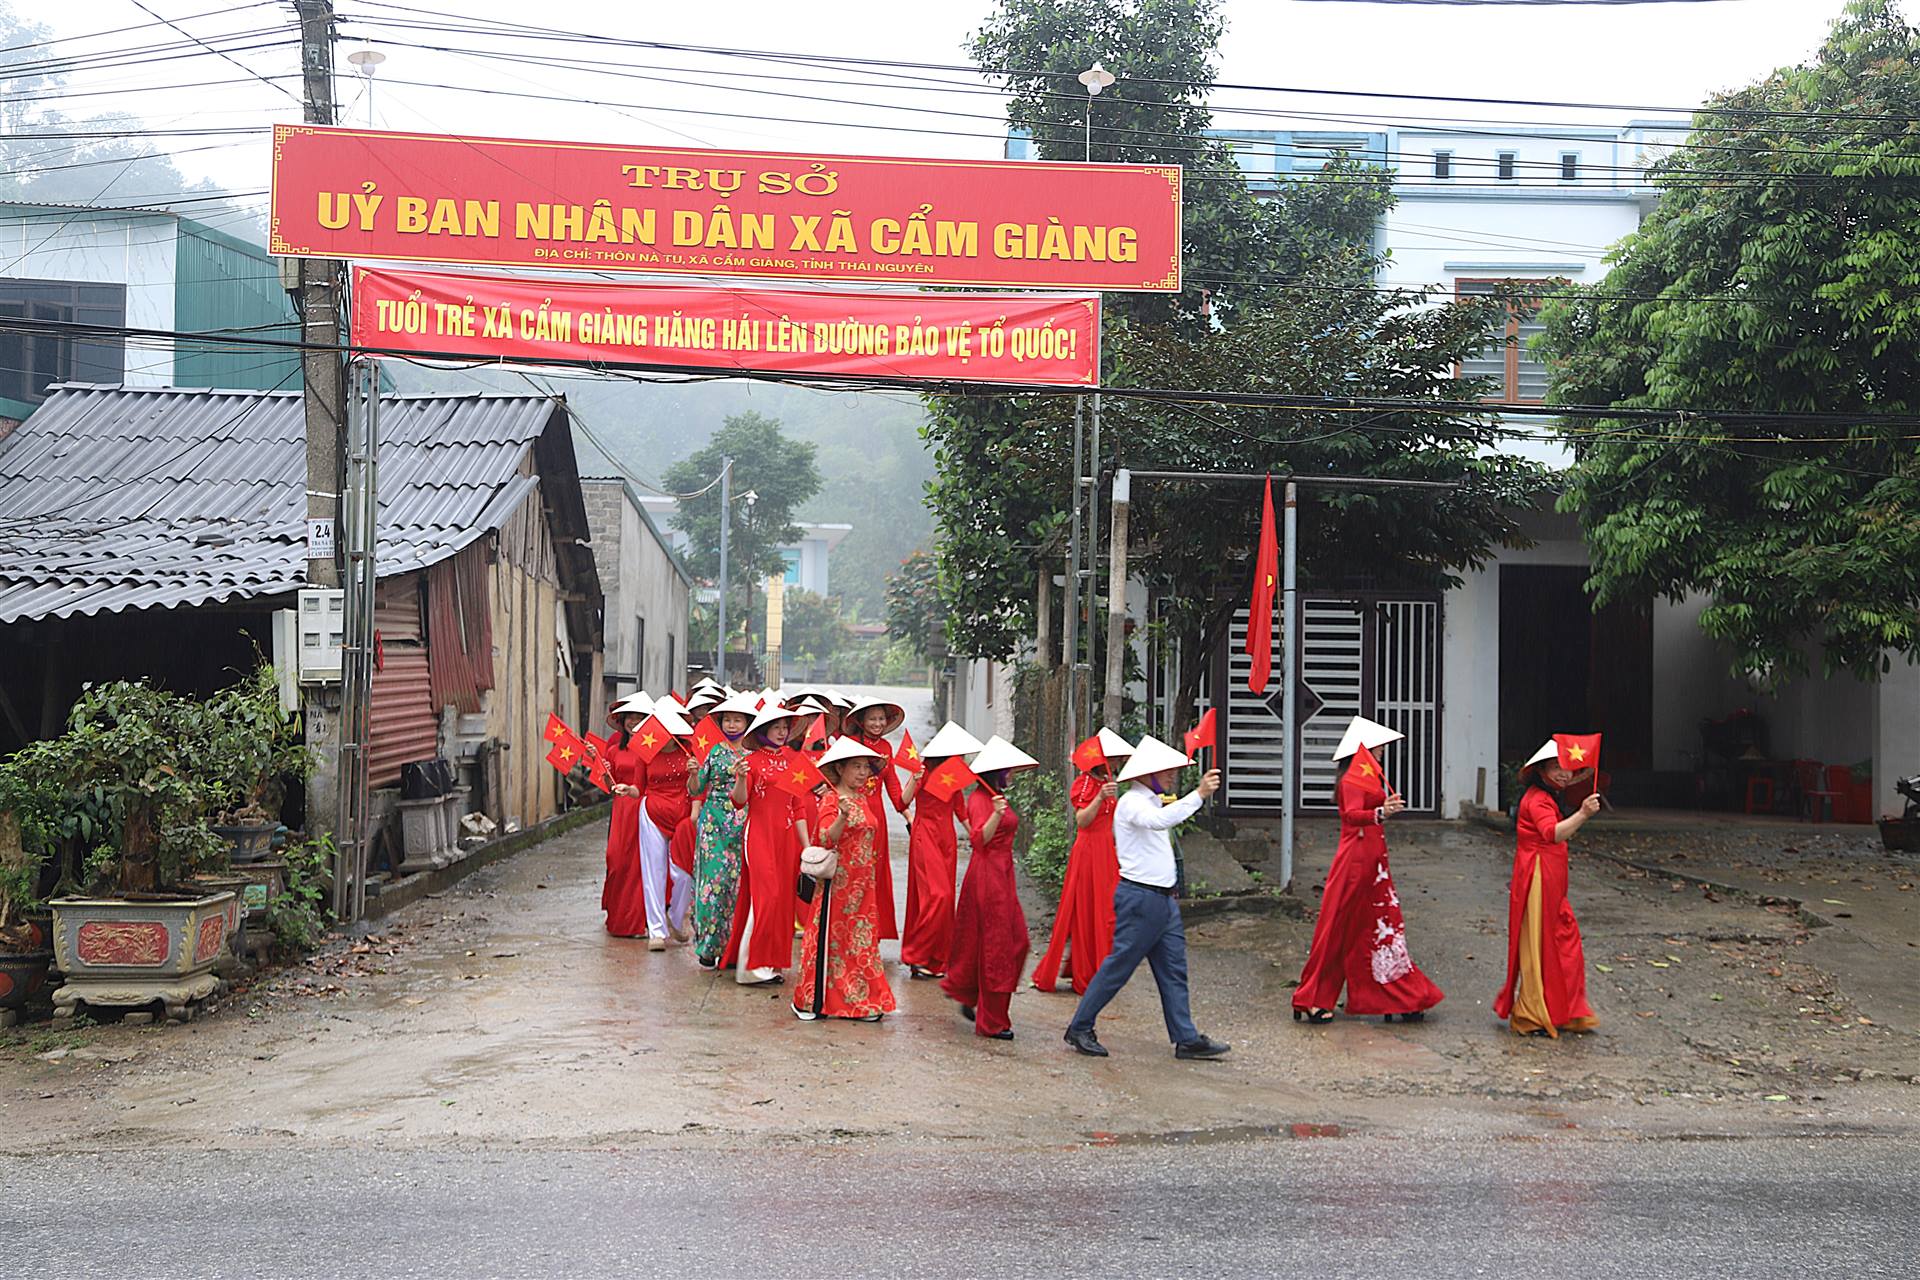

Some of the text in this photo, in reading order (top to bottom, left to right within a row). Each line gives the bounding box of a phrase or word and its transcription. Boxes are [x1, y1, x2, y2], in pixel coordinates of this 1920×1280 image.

[622, 163, 839, 198] TRỤ SỞ
[317, 181, 1137, 262] UỶ BAN NHÂN DÂN XÃ CẨM GIÀNG
[534, 246, 934, 273] ĐỊA CHỈ: THÔN NÀ TU, XÃ CẨM GIÀNG, TỈNH THÁI NGUYÊN
[376, 289, 1077, 364] TUỔI TRẺ XÃ CẨM GIÀNG HĂNG HÁI LÊN ĐƯỜNG BẢO VỆ TỔ QUỐC!
[315, 524, 331, 538] 2.4
